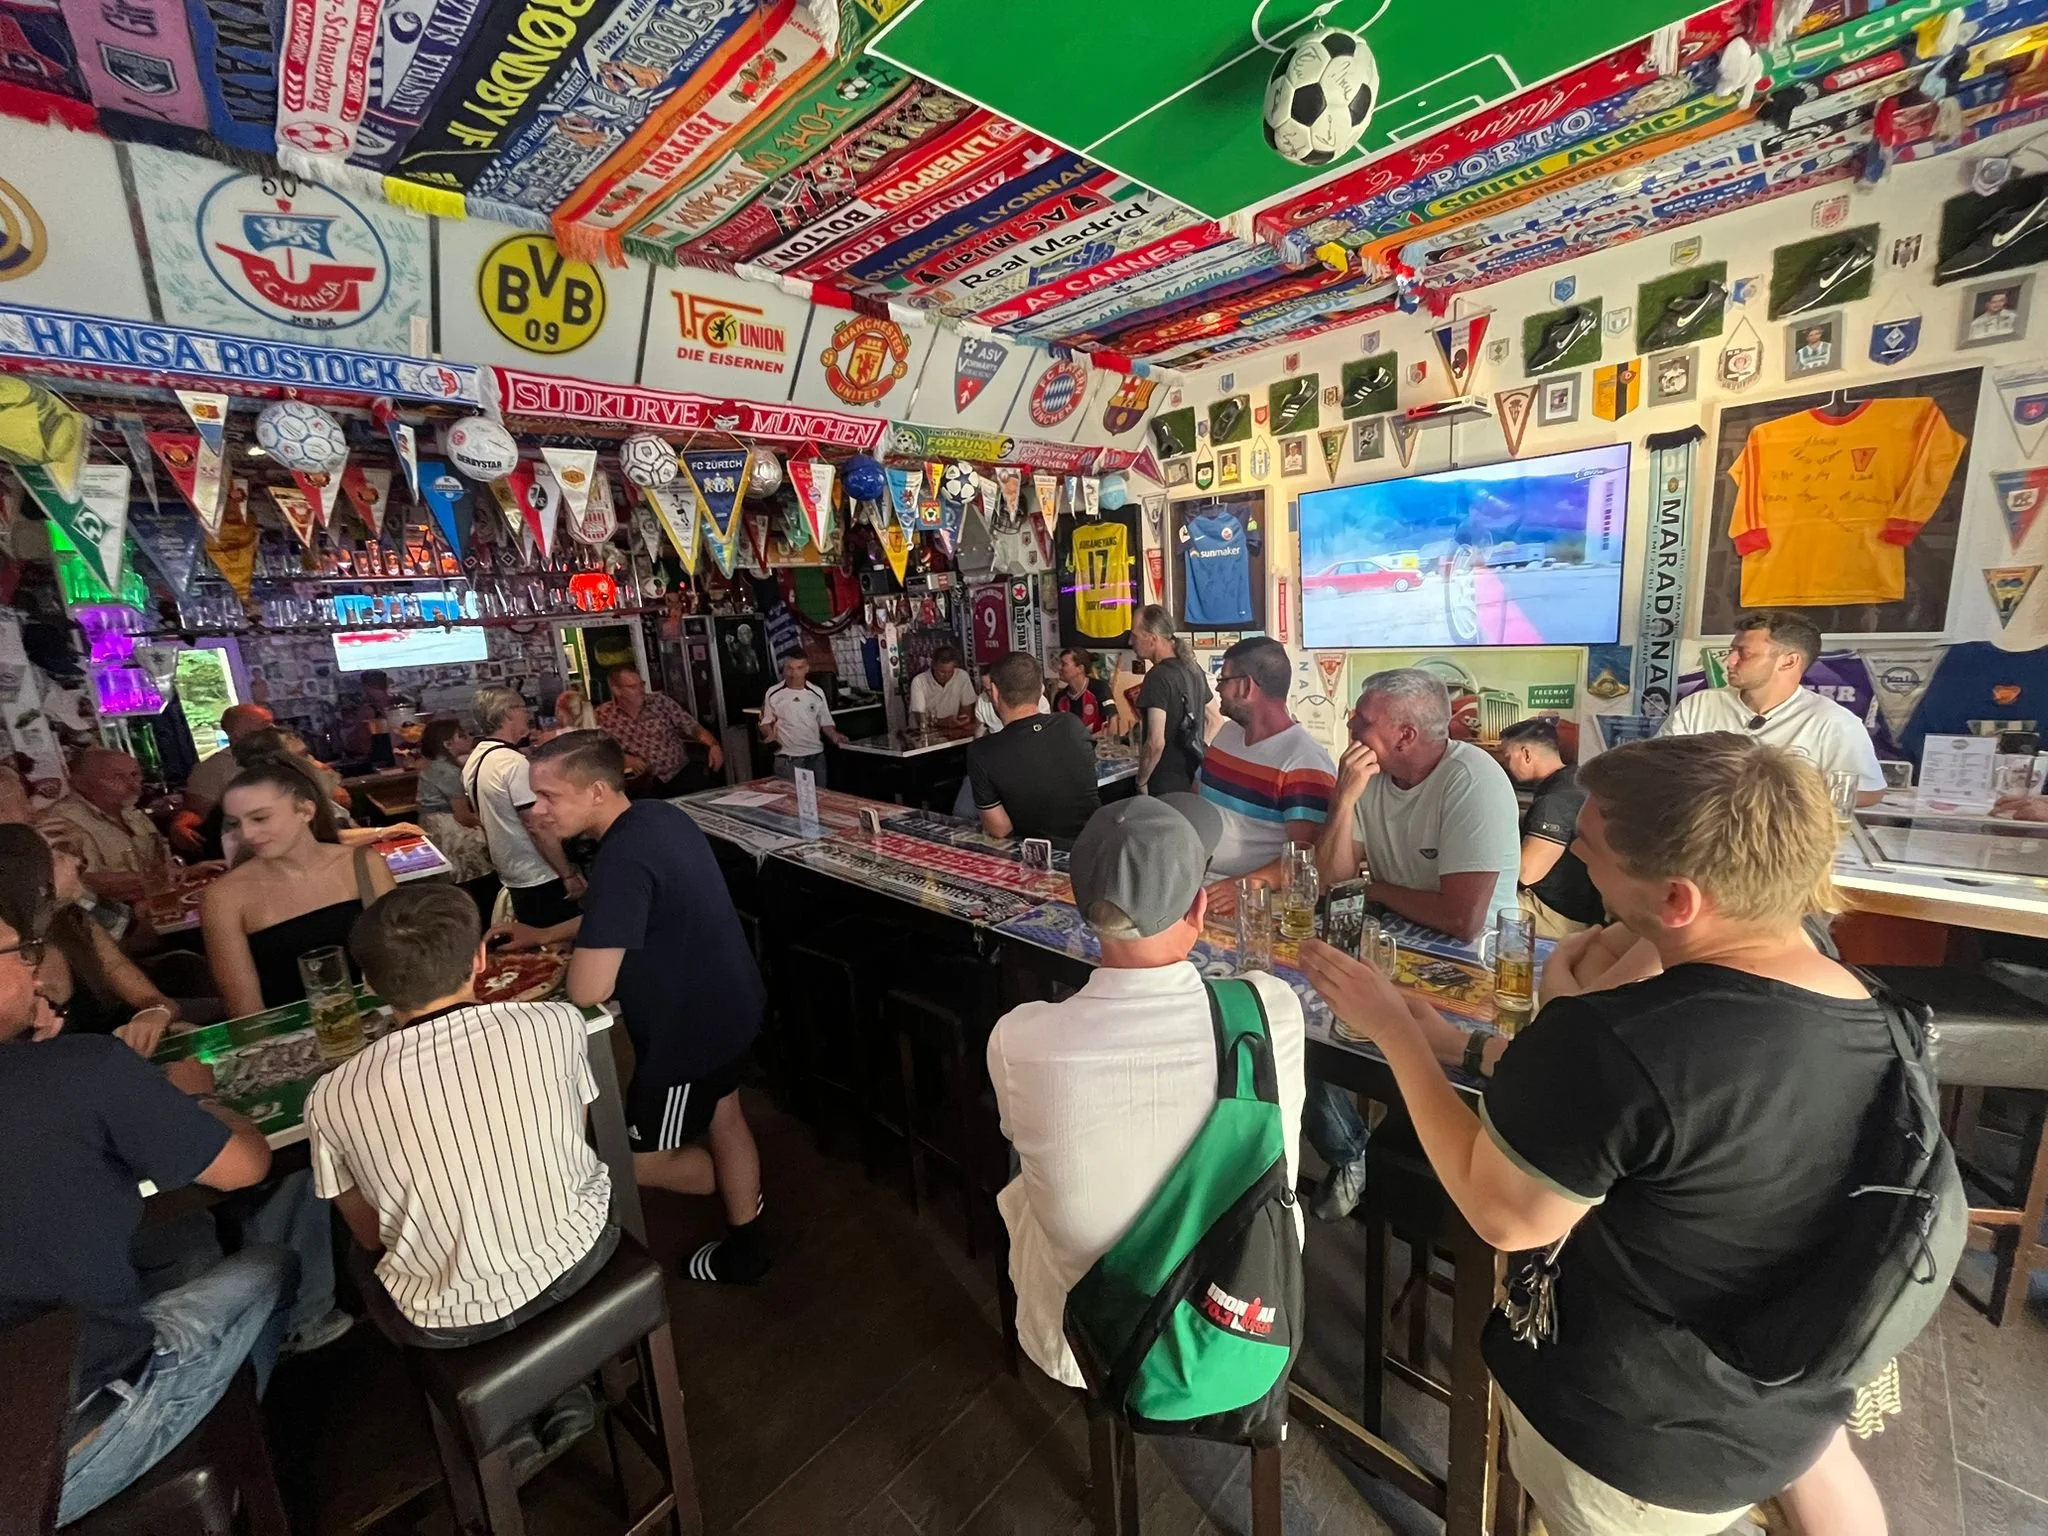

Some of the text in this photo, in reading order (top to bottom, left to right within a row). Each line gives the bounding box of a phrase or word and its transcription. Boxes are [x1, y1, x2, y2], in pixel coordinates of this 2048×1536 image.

[345, 1, 377, 108] EIN TOLLER SPORT
[391, 41, 453, 115] AUSTRIA
[446, 119, 497, 150] IF
[637, 108, 733, 183] Ferrari
[1431, 107, 1594, 189] PORTO
[1439, 163, 1545, 214] SOUTH
[1566, 95, 1713, 166] AFRICA
[872, 136, 999, 209] LIVERPOOL
[1467, 246, 1505, 263] FC
[1511, 203, 1643, 250] BAYERN
[1649, 135, 1847, 205] MÜNCHEN
[772, 209, 869, 263] BOLTON
[864, 222, 978, 282] OLYMPIQUE
[979, 159, 1096, 224] LYONNAIS
[938, 206, 1069, 276] AC Milan
[824, 236, 887, 277] HOPP
[963, 201, 1150, 291] Real Madrid
[1514, 241, 1553, 260] noch
[284, 279, 344, 311] HANSA
[498, 246, 595, 326] BVB
[1025, 287, 1062, 312] AS
[1065, 239, 1196, 293] CANNES
[524, 319, 560, 345] 09
[739, 328, 785, 352] UNION
[25, 314, 209, 371] HANSA
[216, 341, 404, 392] ROSTOCK
[676, 346, 785, 375] DIE EISERNEN
[836, 318, 905, 401] MANCHESTER UNITED
[977, 346, 1003, 363] ASV
[1039, 361, 1086, 394] FC BAYERN
[515, 383, 876, 447] SÜDKURVE MÜNCHEN
[1032, 399, 1076, 424] MÜNCHEN
[457, 453, 502, 469] DERBYSTAR
[691, 458, 743, 470] FC ZÜRICH
[927, 437, 993, 452] FORTUNA
[1038, 448, 1080, 462] BAYERN
[1087, 549, 1110, 590] 17
[1200, 546, 1241, 558] sunmaker
[1648, 498, 1682, 684] MARADONA
[983, 606, 997, 639] 9
[1015, 607, 1025, 623] RED
[1531, 698, 1571, 706] ENTRANCE
[1533, 689, 1570, 698] FREEWAY
